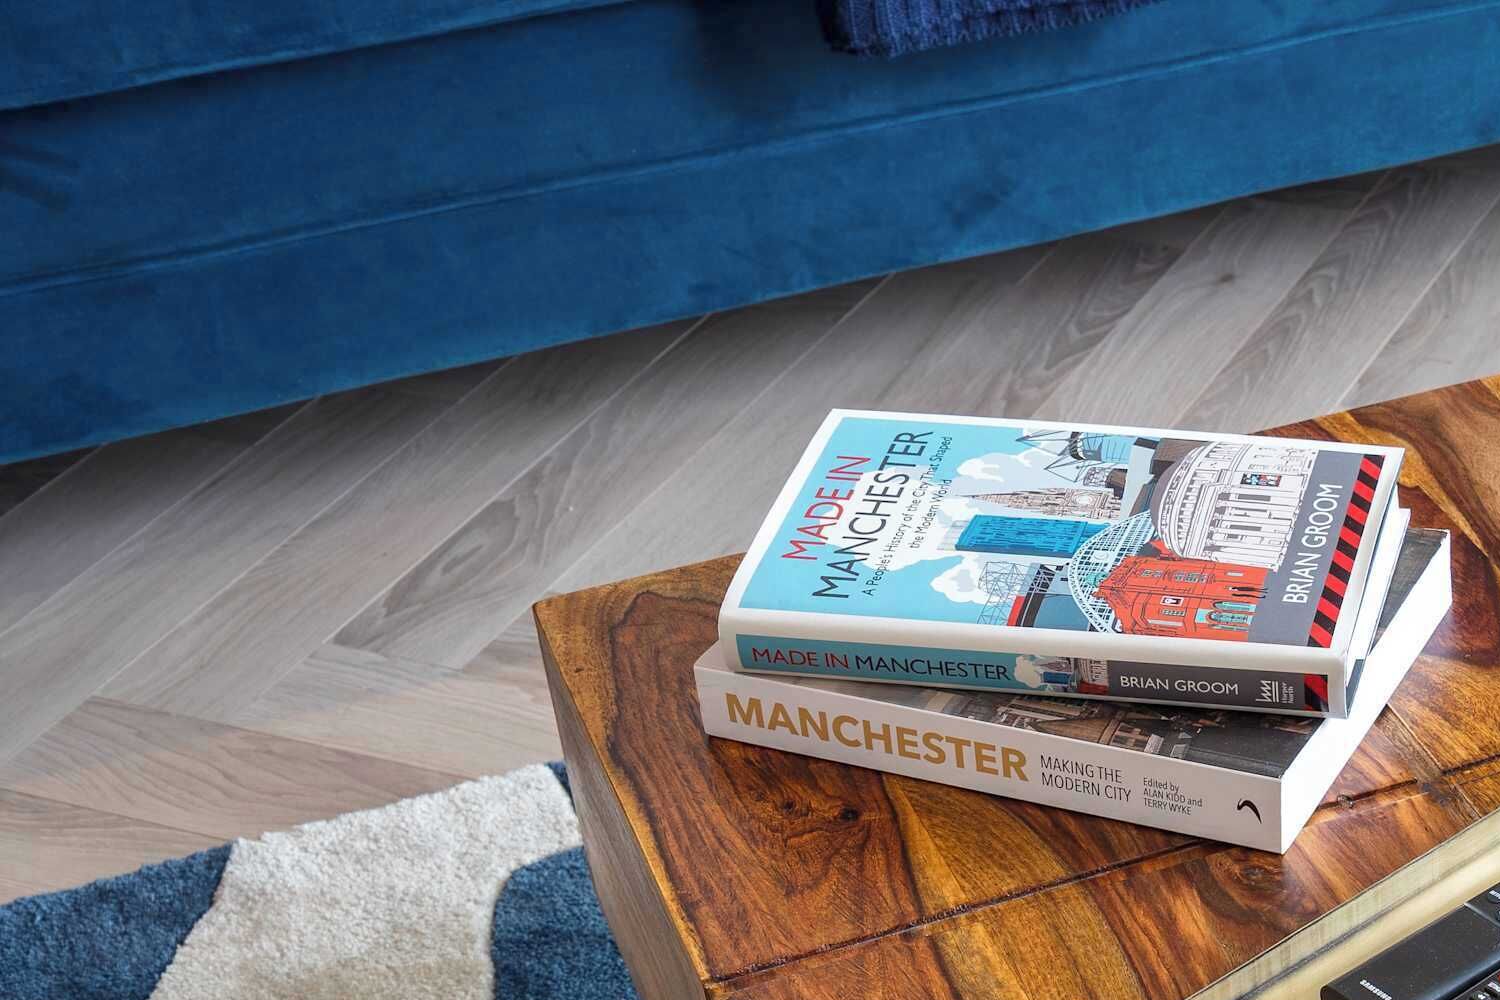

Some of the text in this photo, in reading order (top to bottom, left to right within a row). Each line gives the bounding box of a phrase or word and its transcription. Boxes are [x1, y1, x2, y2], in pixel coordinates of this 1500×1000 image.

[929, 437, 953, 464] Shaped
[920, 463, 941, 482] That
[912, 480, 928, 499] City
[781, 455, 872, 561] MADE IN
[812, 431, 935, 599] MANCHESTER
[908, 499, 921, 513] the
[910, 479, 953, 550] the Modern World
[887, 524, 910, 553] History
[1282, 483, 1344, 605] BRIAN GROOM
[865, 554, 894, 587] People's
[862, 589, 874, 597] A
[751, 647, 1012, 682] MADE IN MANCHESTER
[1120, 675, 1240, 695] BRIAN GROOM
[725, 693, 1029, 782] MANCHESTER
[1040, 754, 1123, 784] MAKING THE
[1041, 772, 1132, 803] MODERN CITY
[1143, 777, 1180, 794] Edited by
[1143, 788, 1203, 808] ALAN KIDD and
[1143, 797, 1192, 816] TERRY WYKE
